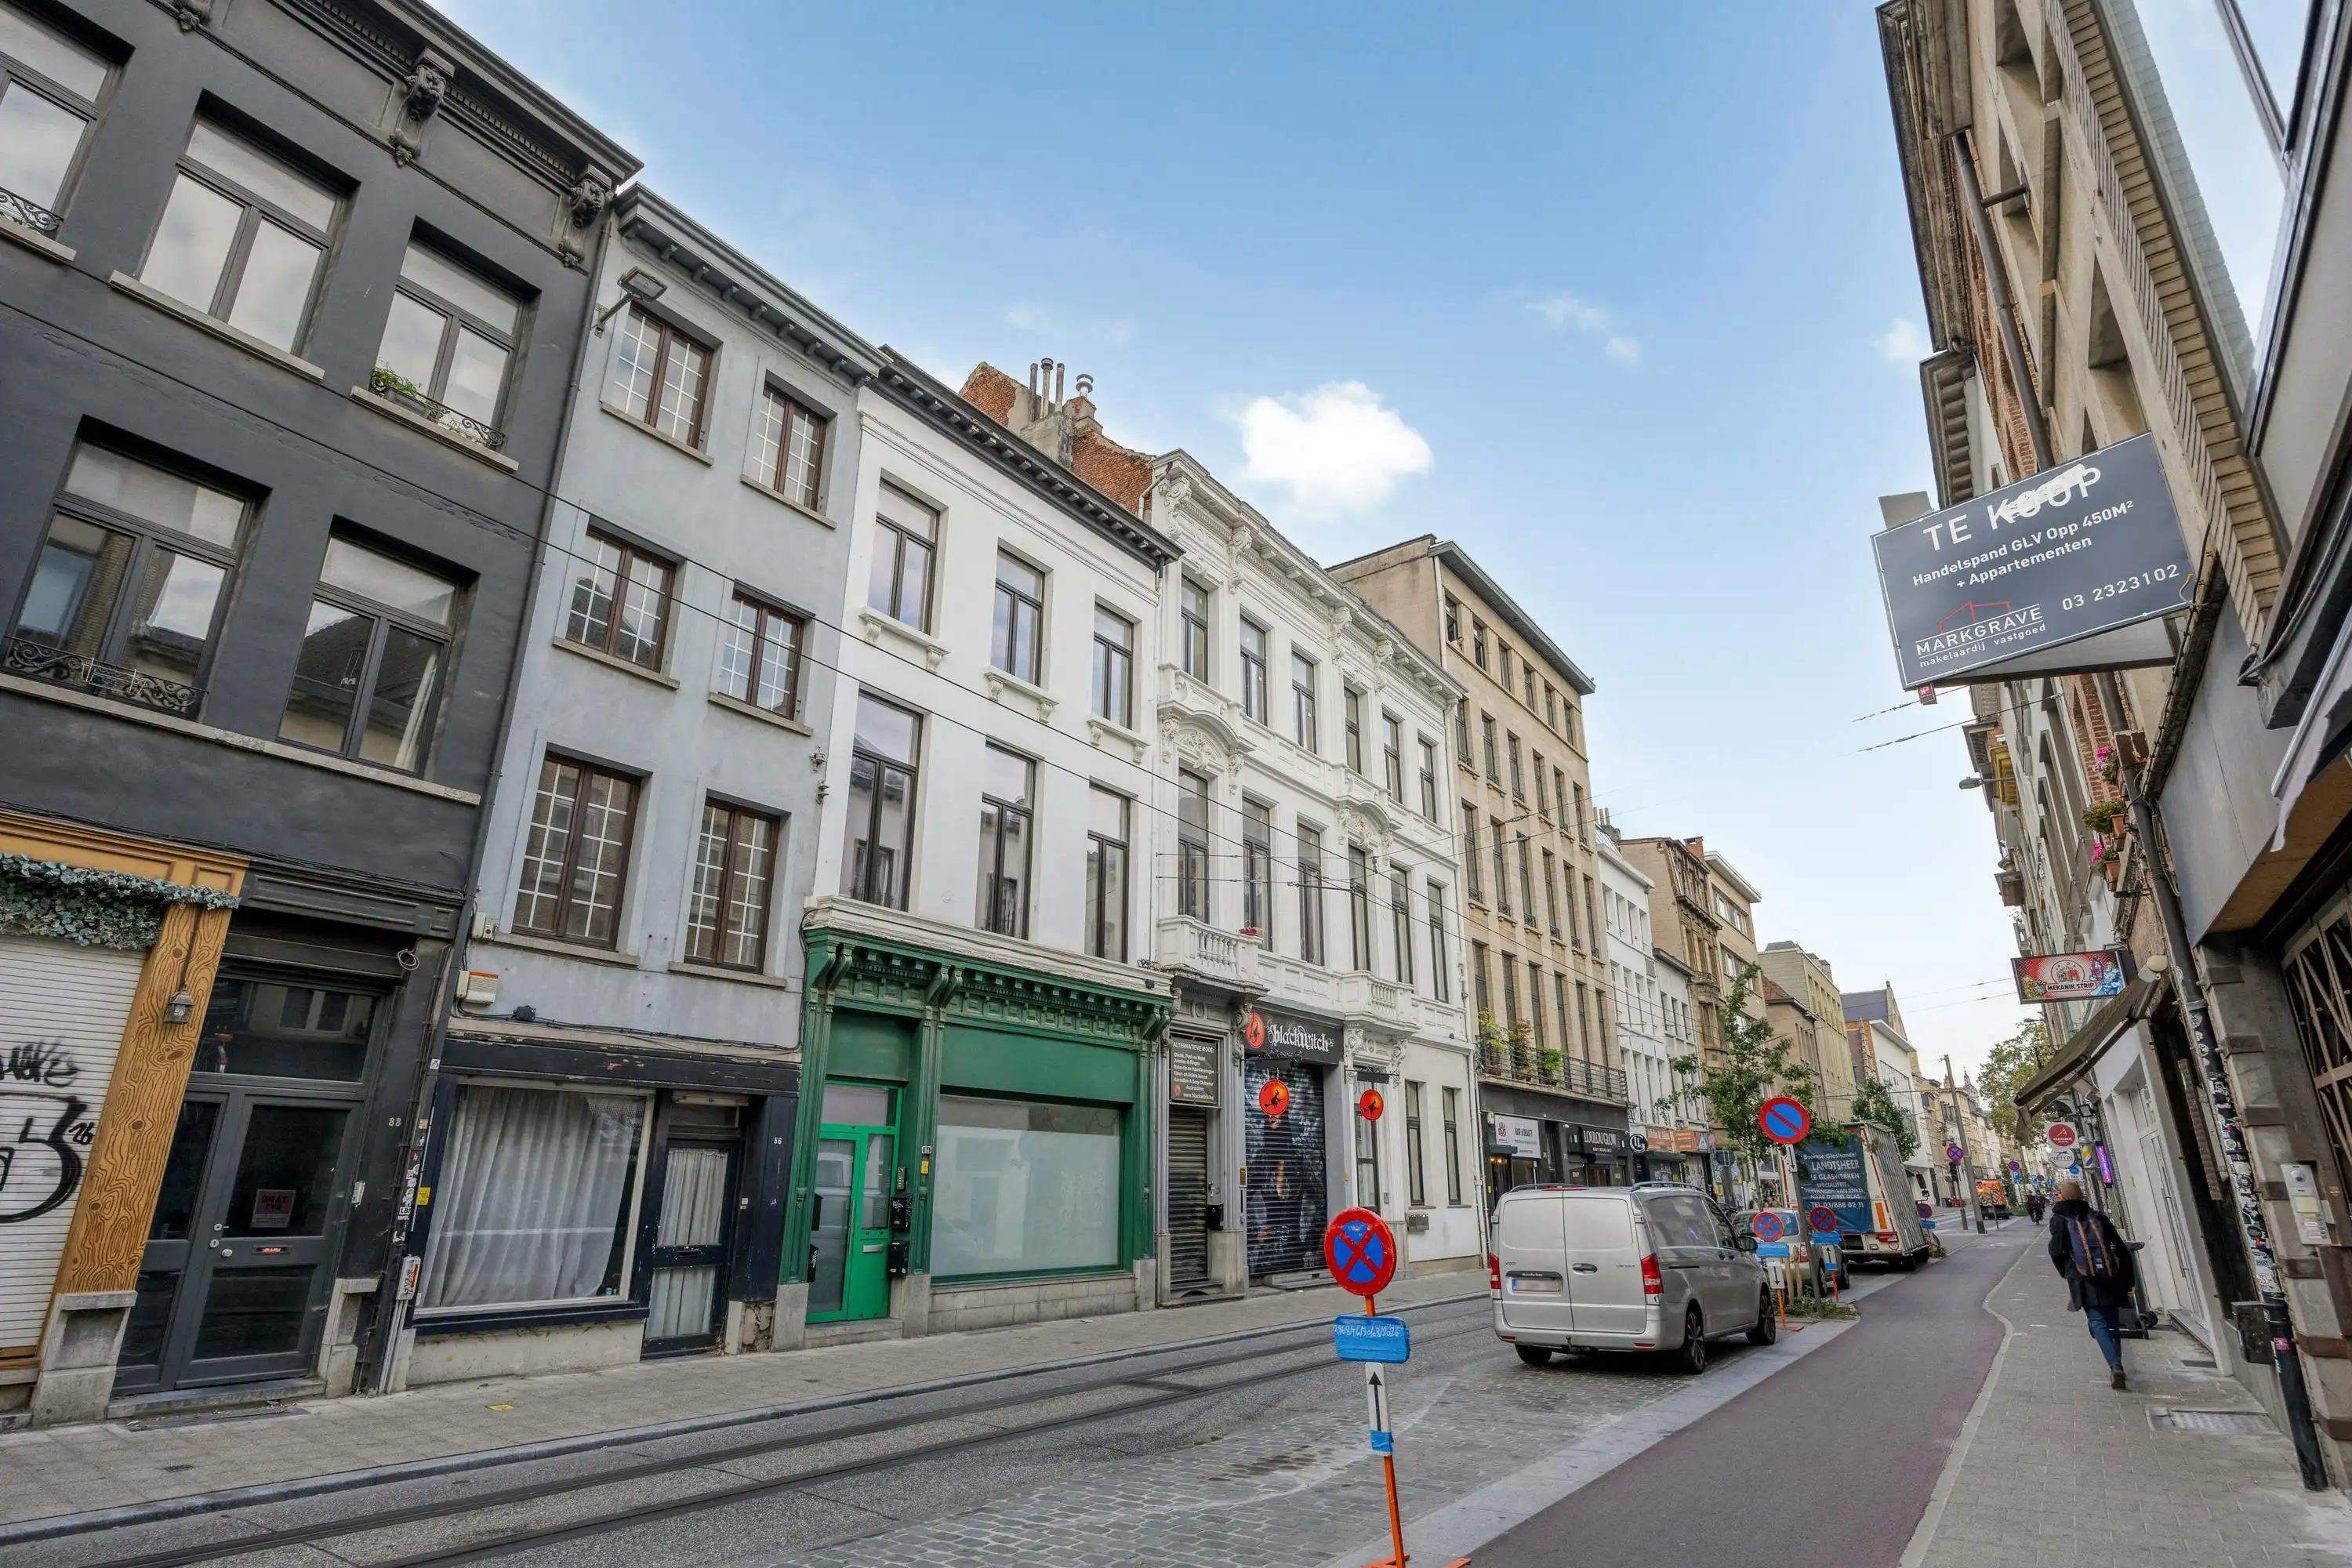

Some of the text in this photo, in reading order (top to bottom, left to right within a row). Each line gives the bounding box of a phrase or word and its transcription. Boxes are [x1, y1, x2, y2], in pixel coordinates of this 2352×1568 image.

[1922, 514, 1972, 551] TE
[1913, 545, 2009, 587] Handelspand
[2011, 532, 2042, 552] GLV
[2046, 523, 2079, 541] Opp
[1956, 536, 2092, 589] + Appartementen
[2061, 564, 2180, 612] 03 2323102
[1916, 608, 2043, 657] MARKGRAVE
[1919, 622, 2046, 669] makelaardij vastgoed
[1173, 1041, 1202, 1051] ALTERNATIEVE
[388, 1117, 402, 1127] 88
[1584, 1130, 1603, 1145] LOULOU
[1811, 1160, 1860, 1171] LANDTSHEER
